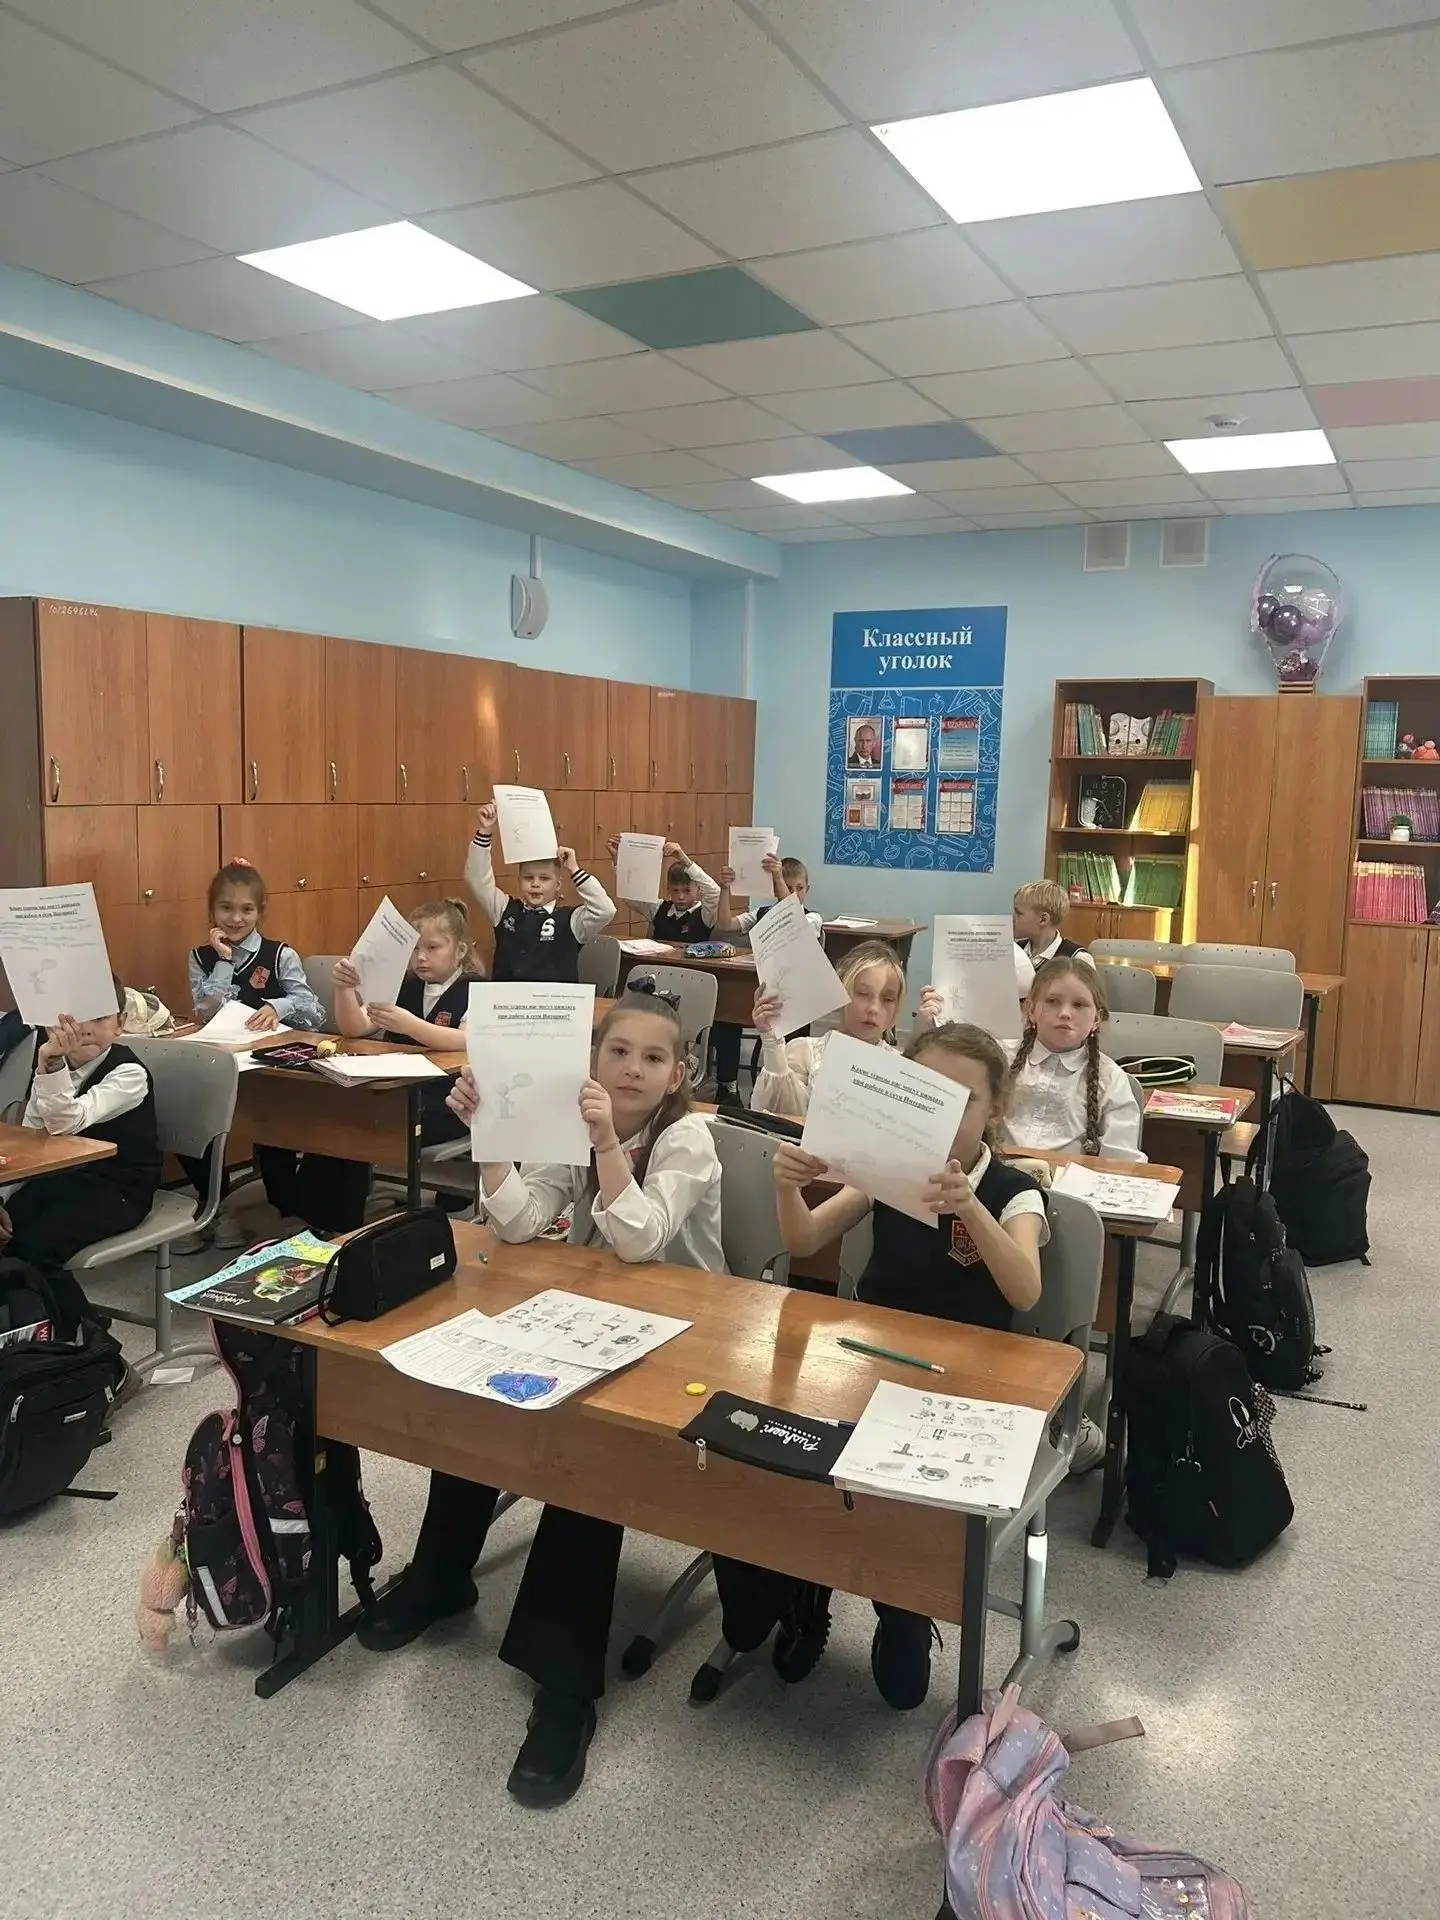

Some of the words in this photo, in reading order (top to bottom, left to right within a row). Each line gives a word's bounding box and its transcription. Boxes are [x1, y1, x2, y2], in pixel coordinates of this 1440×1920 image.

[862, 625, 973, 648] Классный
[879, 654, 953, 676] уголок
[763, 1424, 818, 1451] Pusheen
